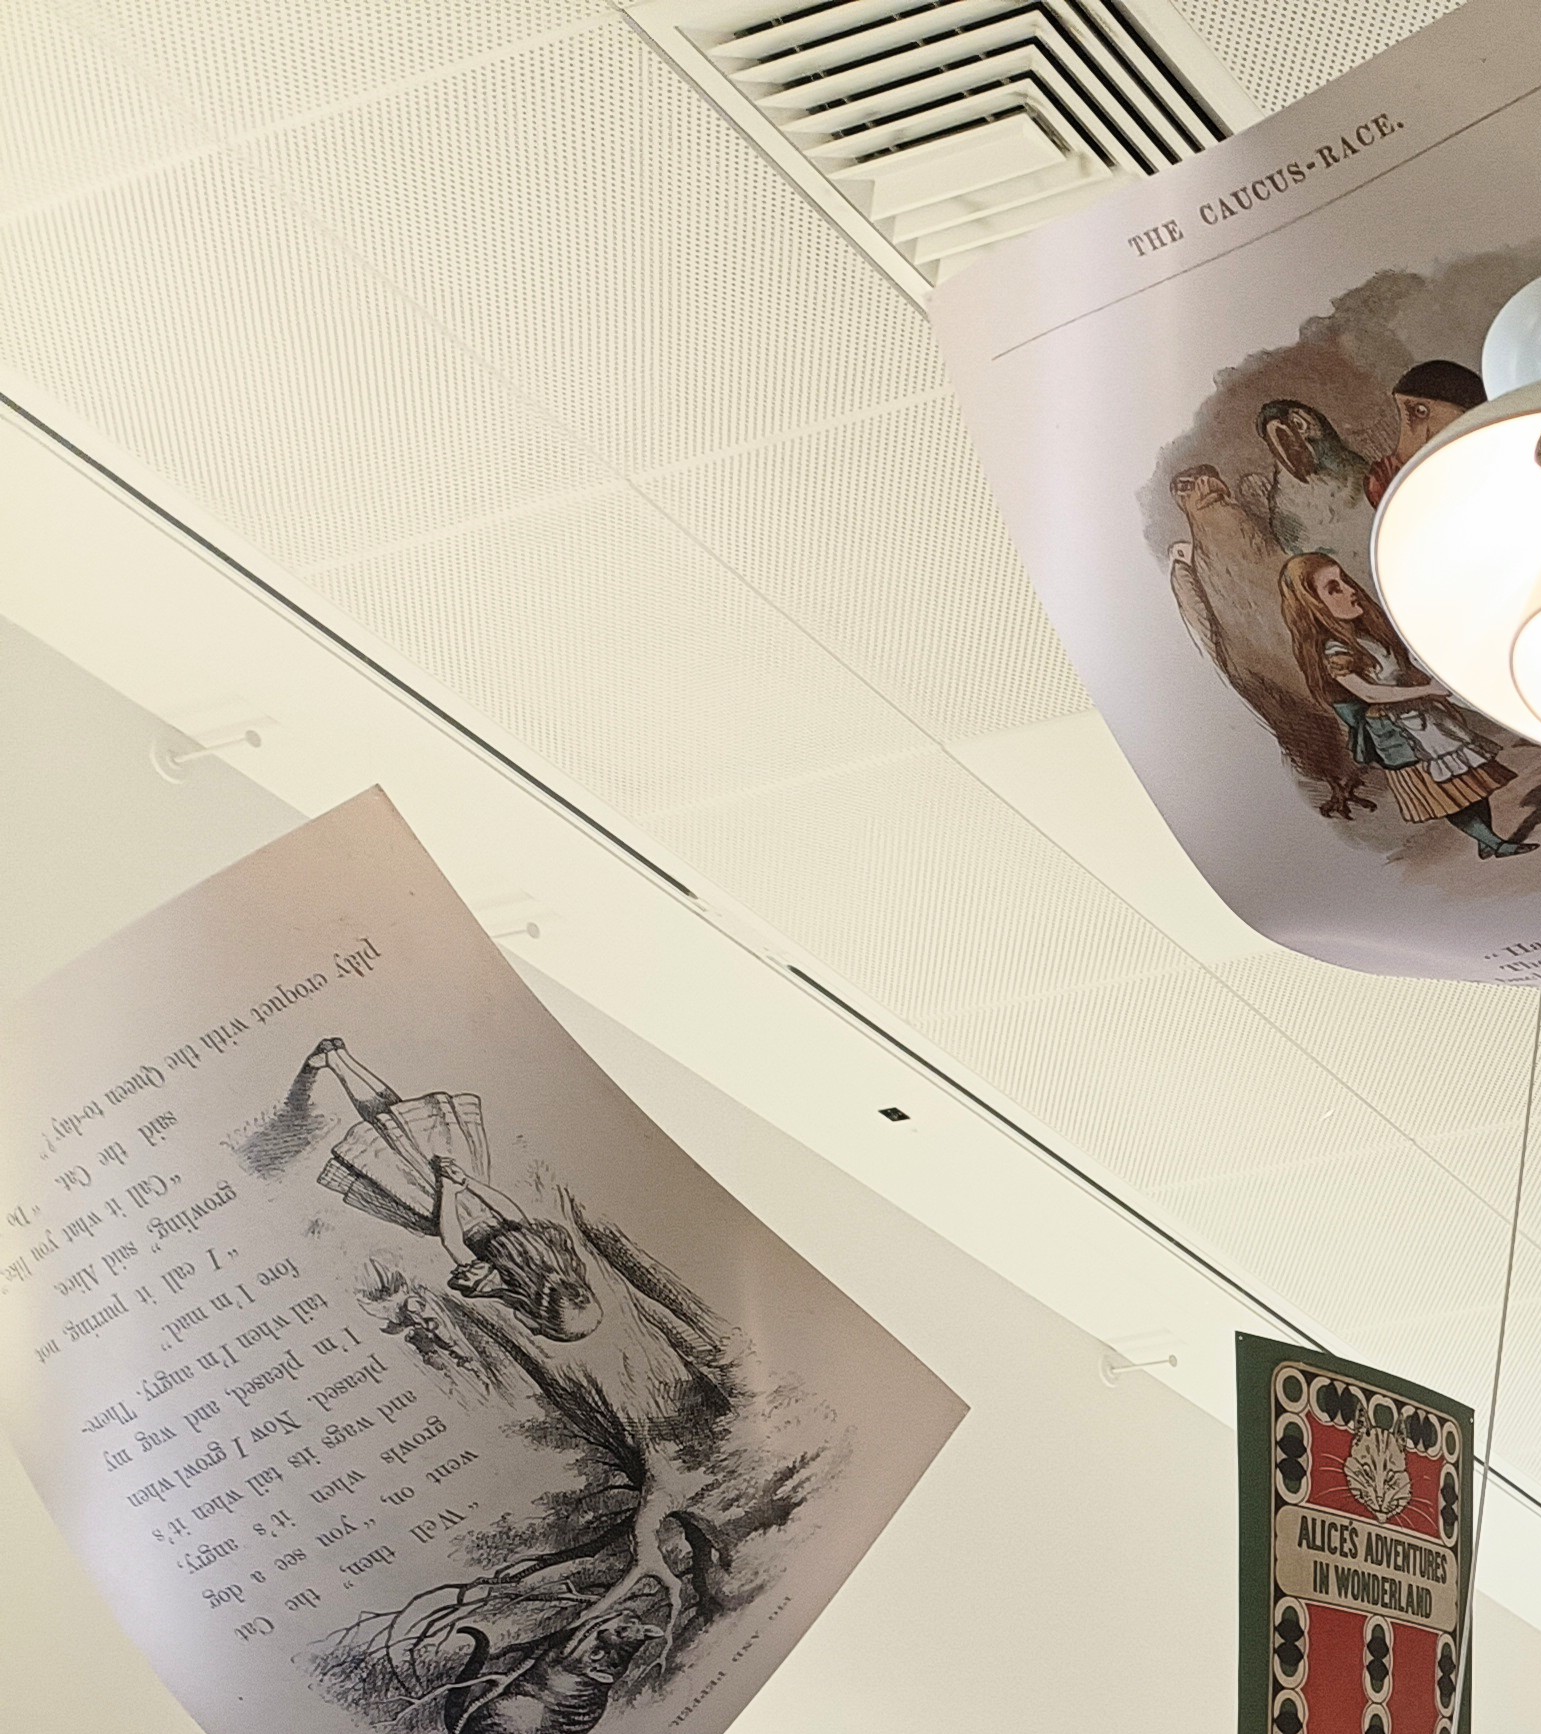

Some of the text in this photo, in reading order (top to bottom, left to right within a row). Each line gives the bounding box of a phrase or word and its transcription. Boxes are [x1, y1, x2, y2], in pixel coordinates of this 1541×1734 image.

[1127, 113, 1404, 256] THE CAUCUS-RACE.
[250, 973, 328, 1024] croquet
[199, 1018, 250, 1054] with
[167, 1044, 201, 1070] the
[104, 1065, 165, 1105] Queen
[376, 1390, 417, 1424] and
[126, 1353, 388, 1507] pleased. Now I growl when
[321, 1416, 375, 1449] wags
[380, 1415, 447, 1464] growls
[287, 1446, 321, 1468] its
[425, 1450, 479, 1484] went
[244, 1466, 283, 1497] tail
[309, 1470, 366, 1503] when
[380, 1487, 415, 1505] on,
[191, 1489, 245, 1520] when
[177, 1538, 239, 1574] angry,
[274, 1548, 307, 1571] see
[1298, 1515, 1448, 1585] ALICE'S ADVENTURES
[250, 1570, 266, 1583] a
[1313, 1560, 1433, 1619] IN WONDERLAND
[202, 1584, 246, 1609] dog
[284, 1588, 321, 1611] the
[235, 1616, 275, 1641] Cat
